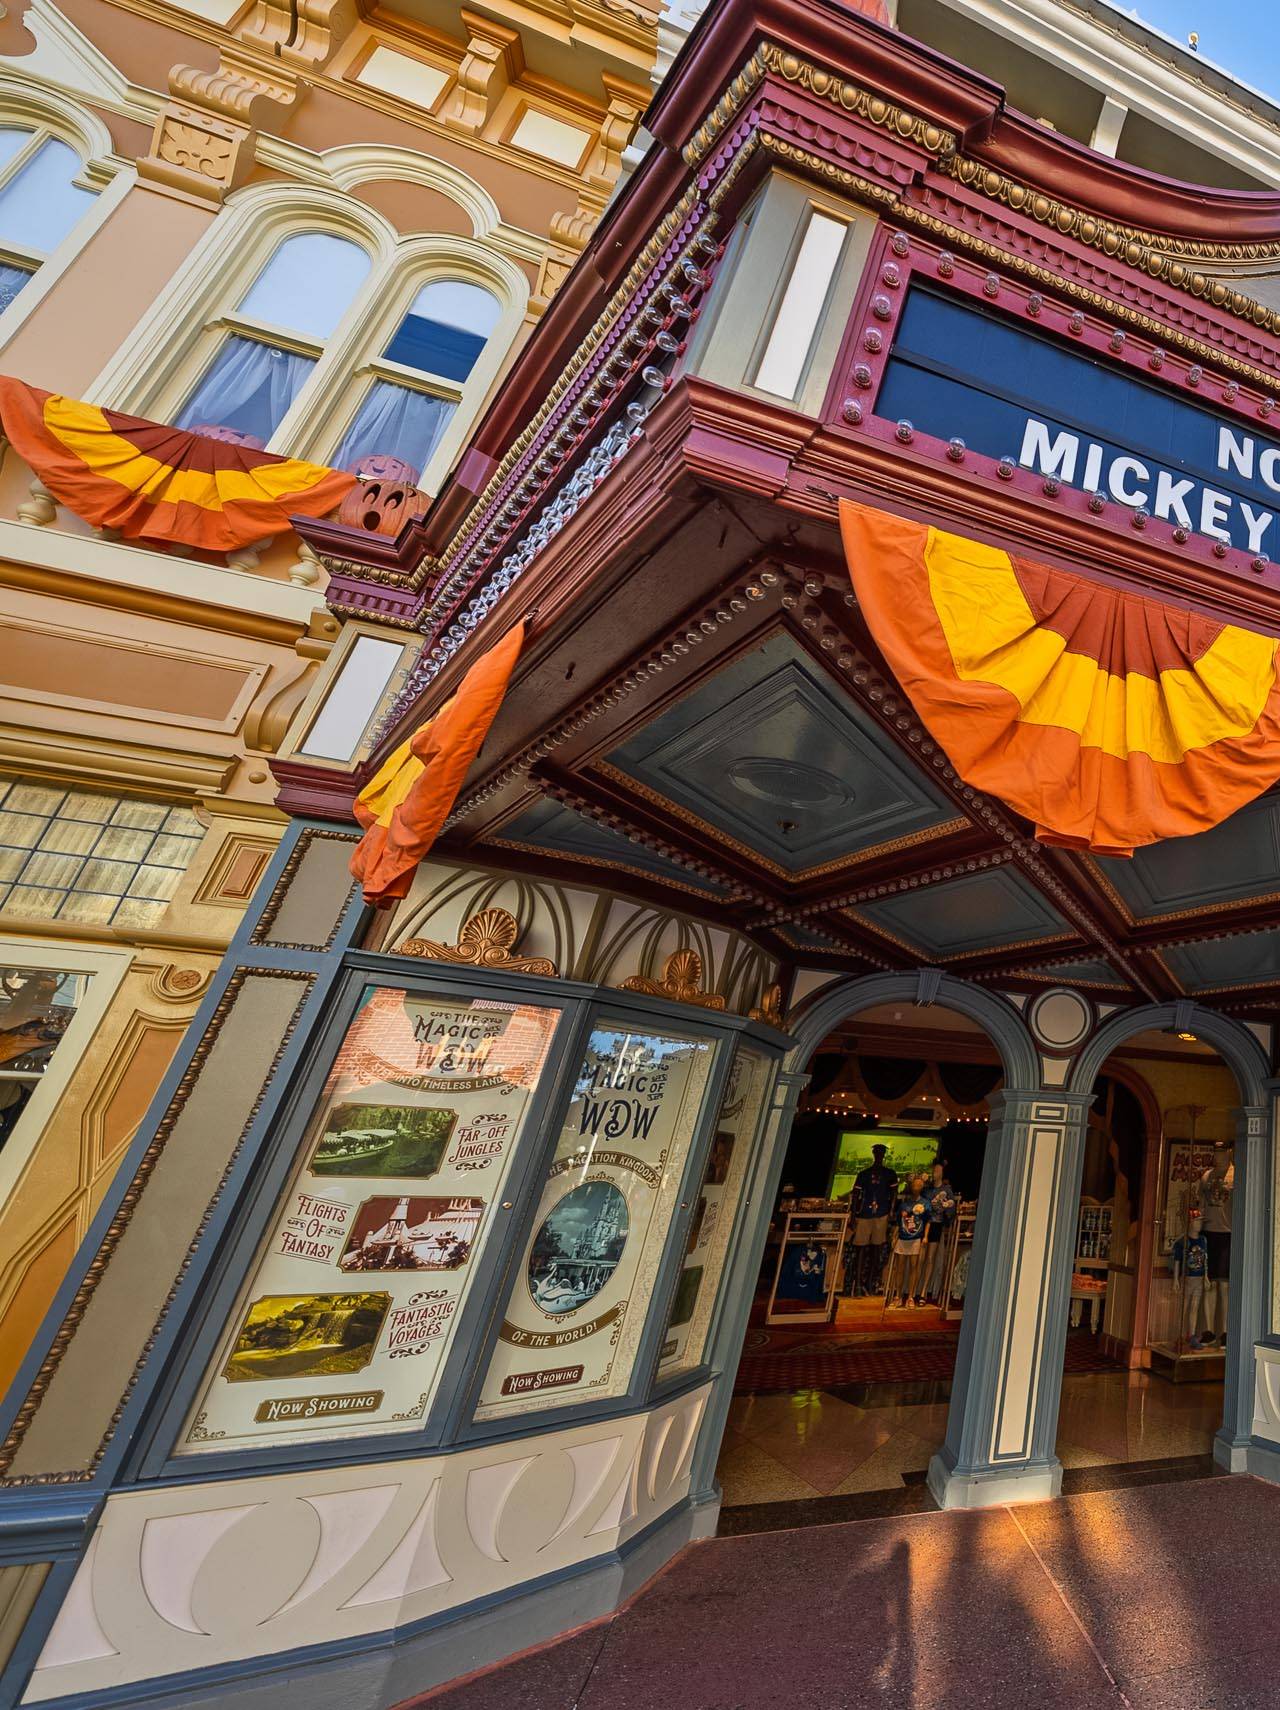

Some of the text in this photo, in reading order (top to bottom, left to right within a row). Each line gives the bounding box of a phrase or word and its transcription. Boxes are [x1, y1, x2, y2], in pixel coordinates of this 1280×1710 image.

[1019, 417, 1274, 555] MICKEY
[414, 1015, 480, 1043] MAGIC
[454, 1013, 479, 1024] THE
[424, 1081, 471, 1091] TIMELESS
[650, 1083, 665, 1093] OF
[579, 1092, 660, 1141] WDW
[458, 1126, 509, 1145] FAR-OFF
[448, 1140, 503, 1162] JUNGLES
[619, 1157, 655, 1182] KINGDOM
[298, 1195, 348, 1223] FLIGHTS
[281, 1232, 336, 1259] FANTASY
[391, 1300, 455, 1329] FANTASTIC
[388, 1322, 442, 1348] VOYAGES
[512, 1322, 597, 1346] OF THE WORLD!
[508, 1370, 579, 1393] NOW SHOWING
[267, 1396, 375, 1420] NOW SHOWING
